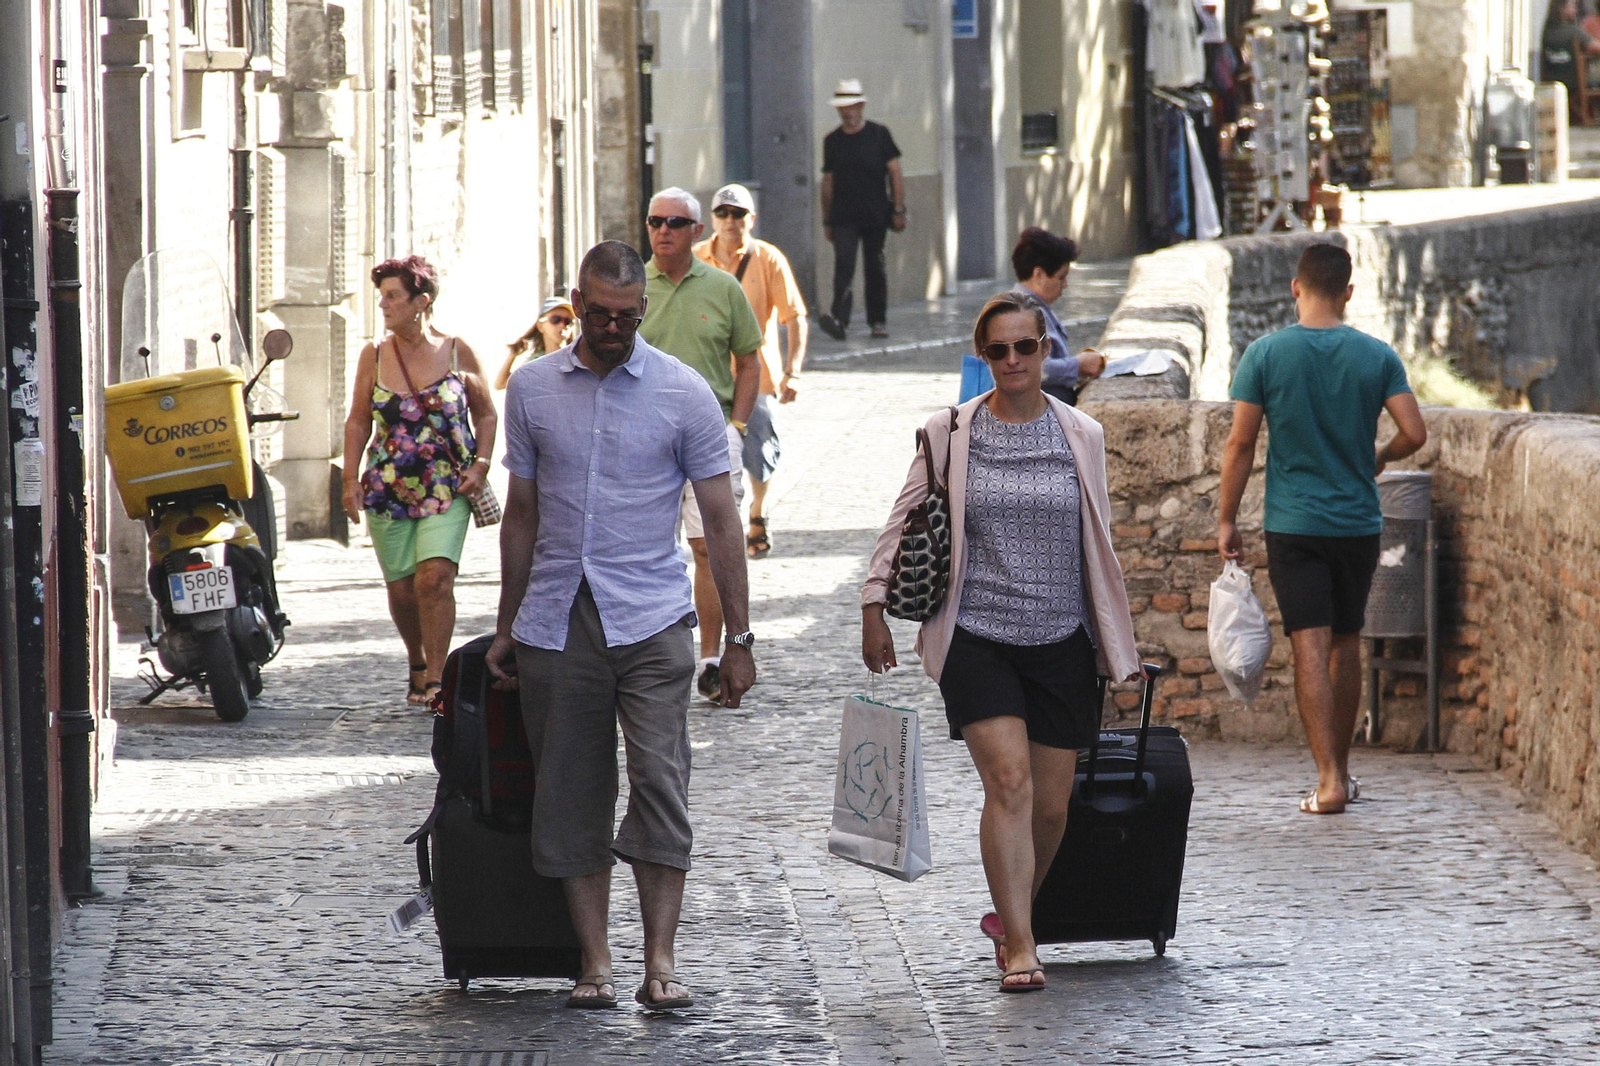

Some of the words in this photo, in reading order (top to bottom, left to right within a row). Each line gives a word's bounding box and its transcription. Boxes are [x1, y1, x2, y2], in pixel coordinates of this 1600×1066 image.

[144, 416, 228, 445] CORREOS
[183, 569, 229, 591] 5806
[191, 589, 226, 611] FHF
[899, 717, 909, 769] Alhambra
[898, 771, 906, 780] la
[898, 782, 905, 796] de
[892, 835, 901, 867] tienda
